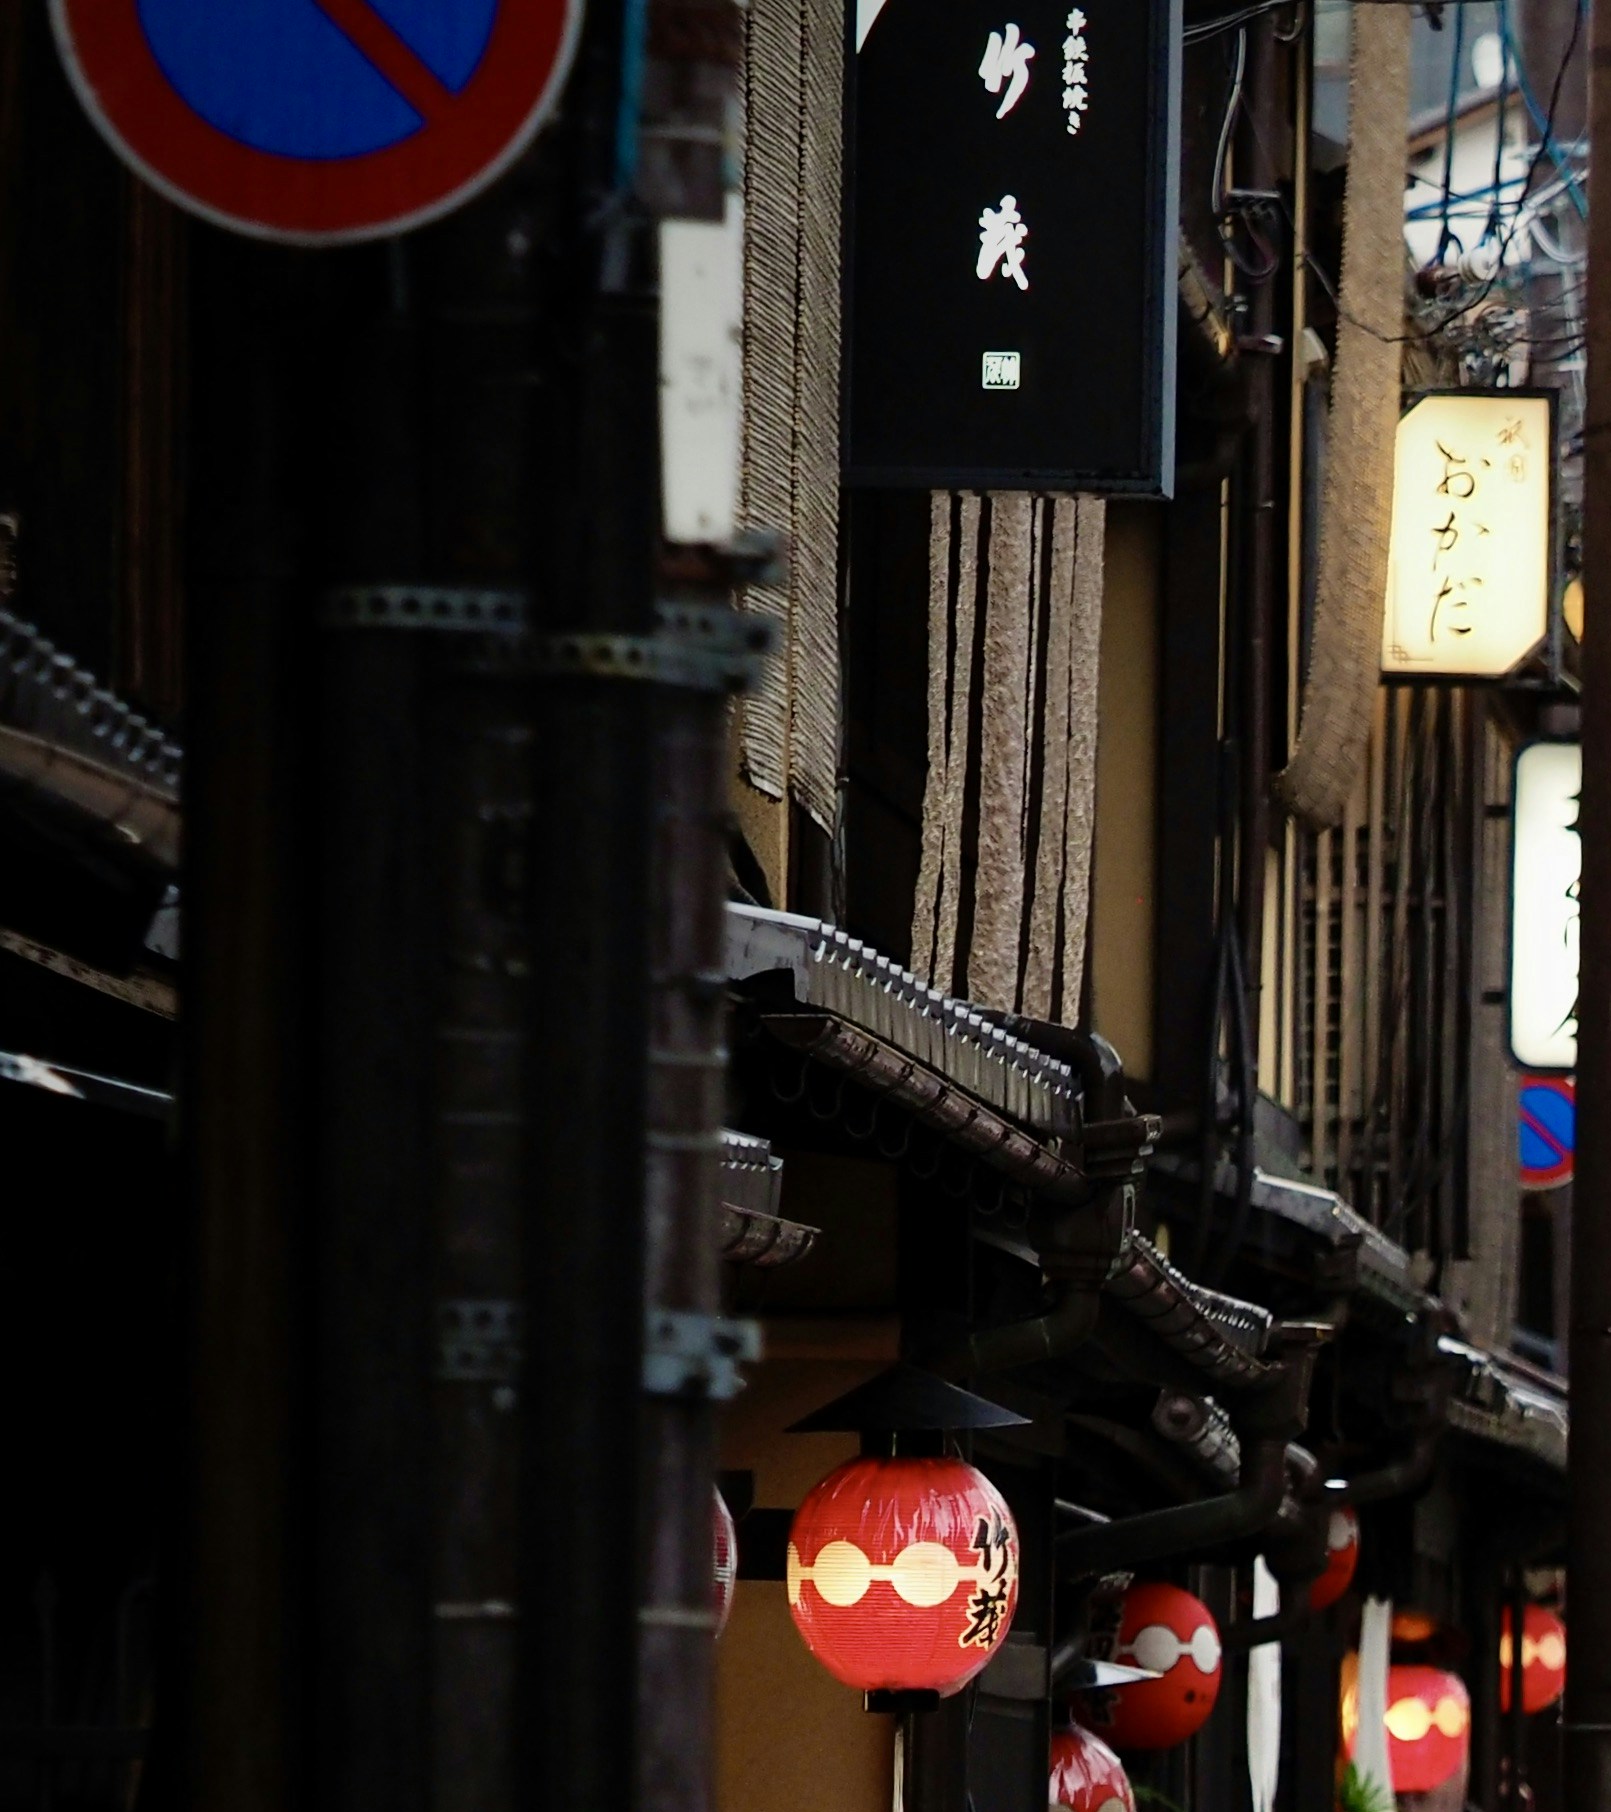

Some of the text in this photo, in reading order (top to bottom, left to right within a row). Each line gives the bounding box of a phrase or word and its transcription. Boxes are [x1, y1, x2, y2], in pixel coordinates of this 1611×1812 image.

[976, 22, 1036, 290] 竹茂
[1431, 440, 1491, 643] おかだ
